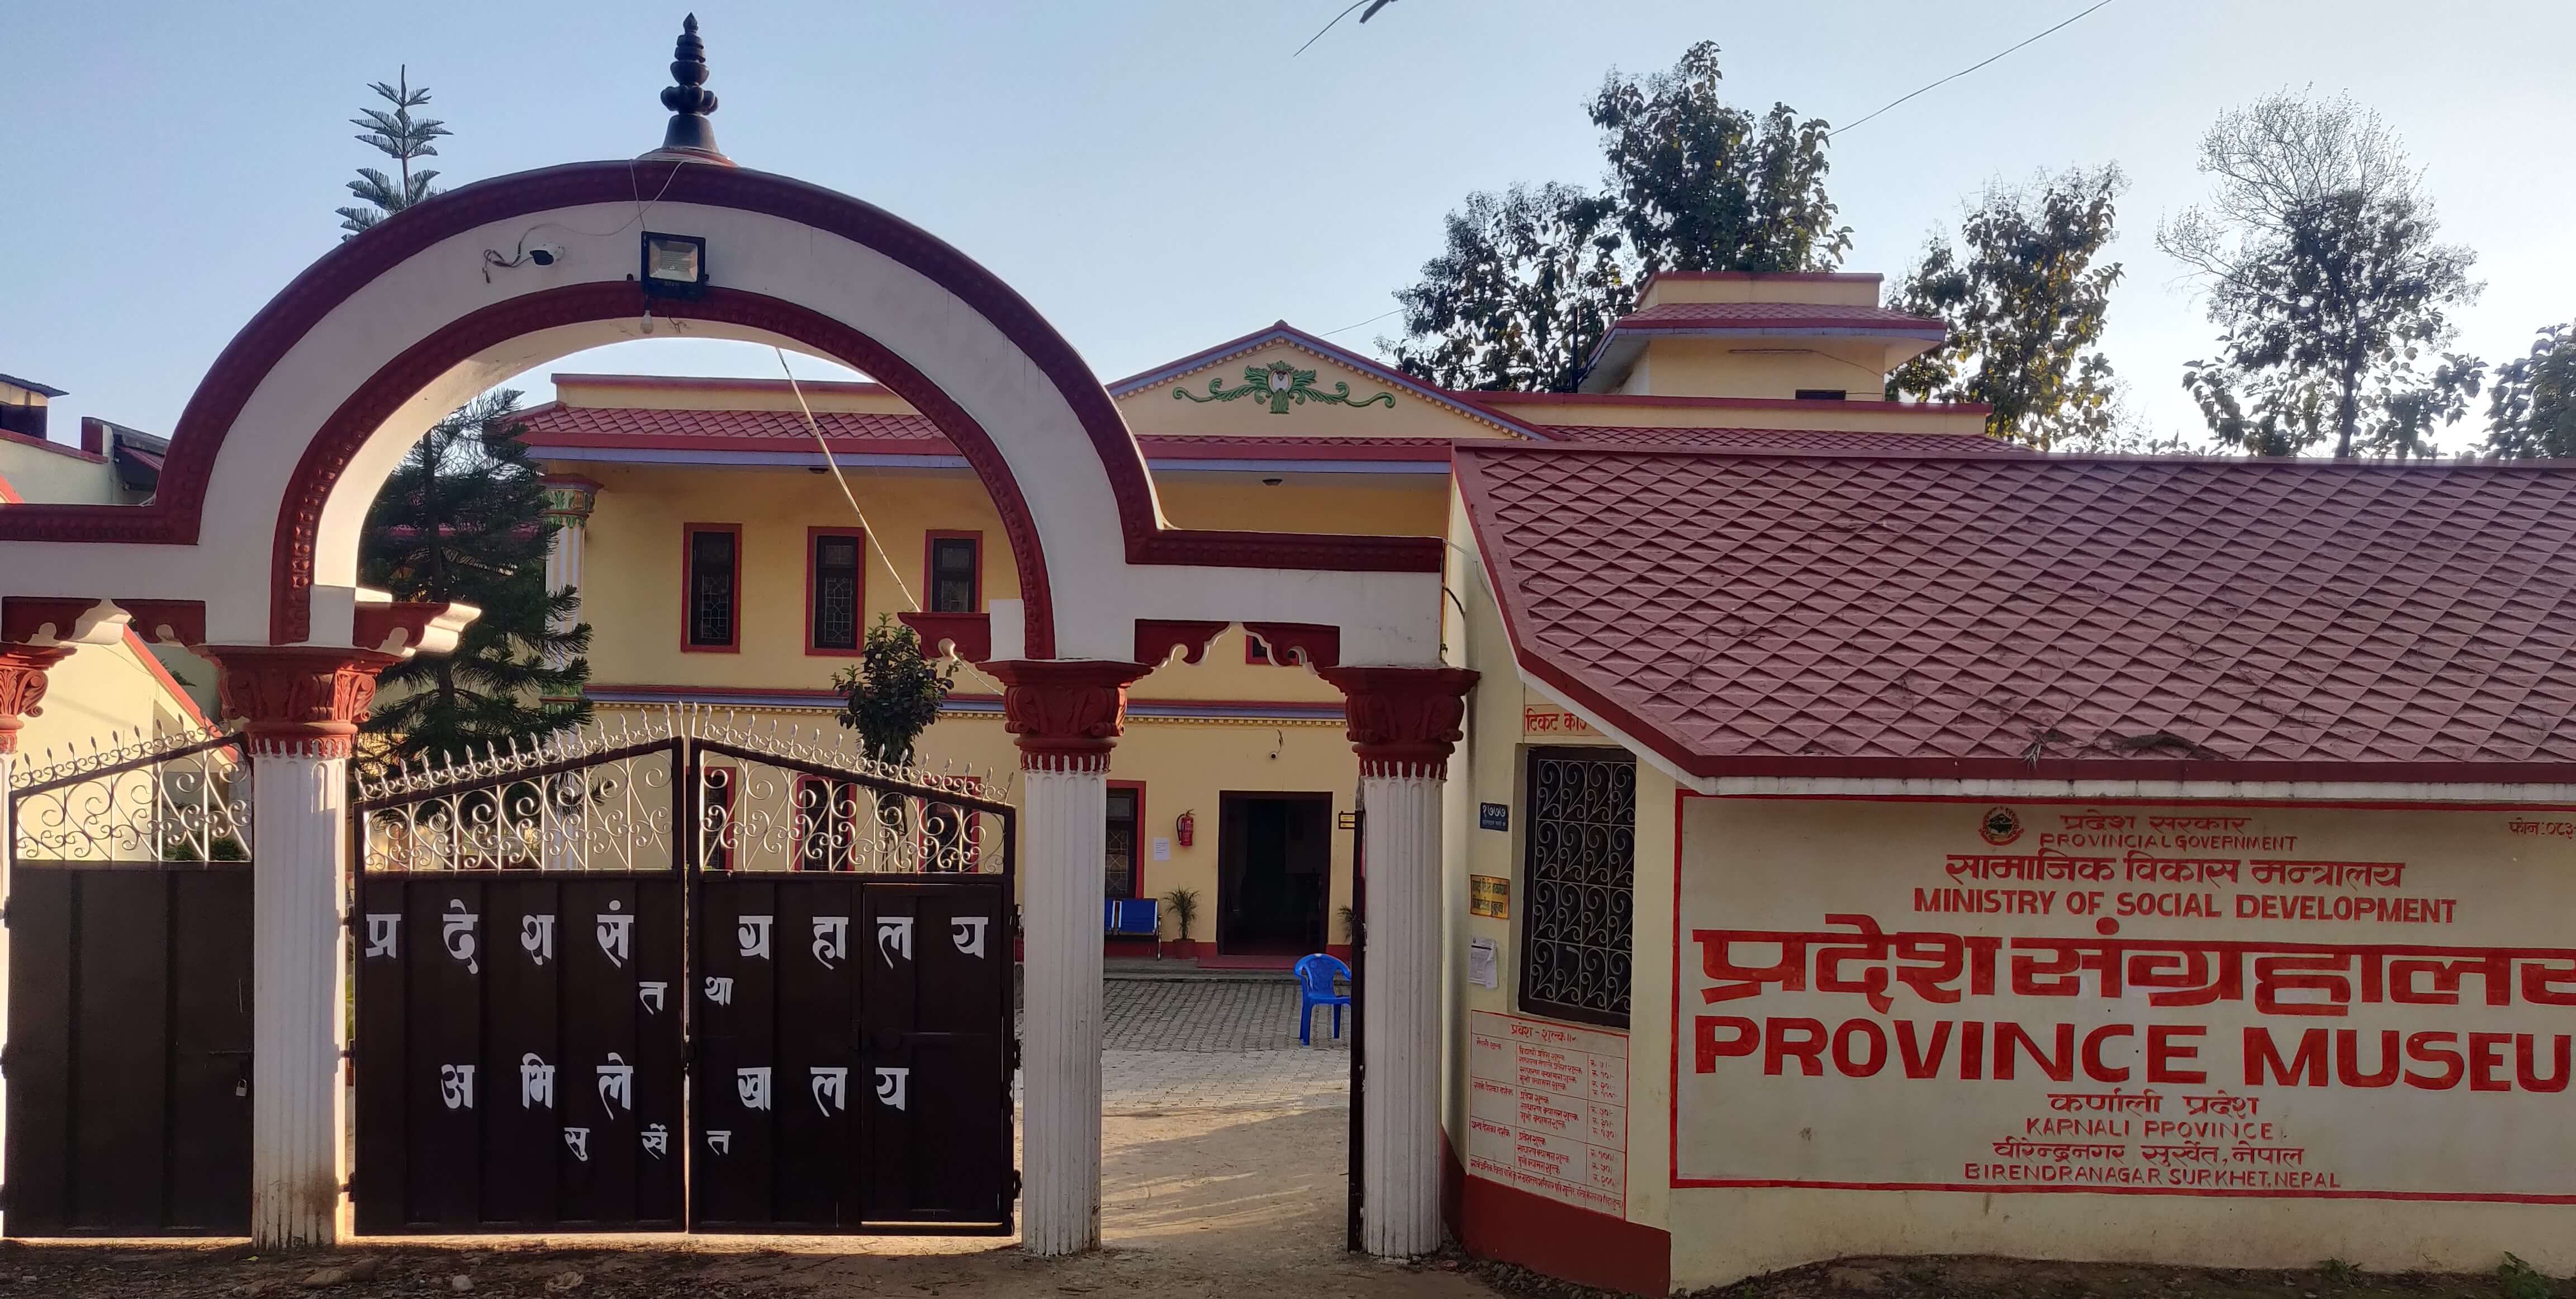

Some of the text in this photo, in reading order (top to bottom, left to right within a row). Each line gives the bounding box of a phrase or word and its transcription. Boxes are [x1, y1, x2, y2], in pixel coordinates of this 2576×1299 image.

[1525, 708, 1559, 732] टिकट
[2059, 809, 2252, 835] प्रदेश सरकार
[2039, 833, 2297, 852] PROVINCIAL GOVERNMENT
[1946, 848, 2406, 890] सामाजिक विकास मन्त्रालय
[1914, 888, 2457, 924] MINISTRY OF SOCIAL DEVELOPMENT
[1695, 1015, 2207, 1084] PROVINCE
[2047, 1088, 2259, 1119] कर्णाली प्रदेश
[1993, 1135, 2126, 1163] वीरेन्द्रनगर
[2231, 1140, 2304, 1167] नेपाल
[1964, 1163, 2163, 1185] BIRENDRANAGAR
